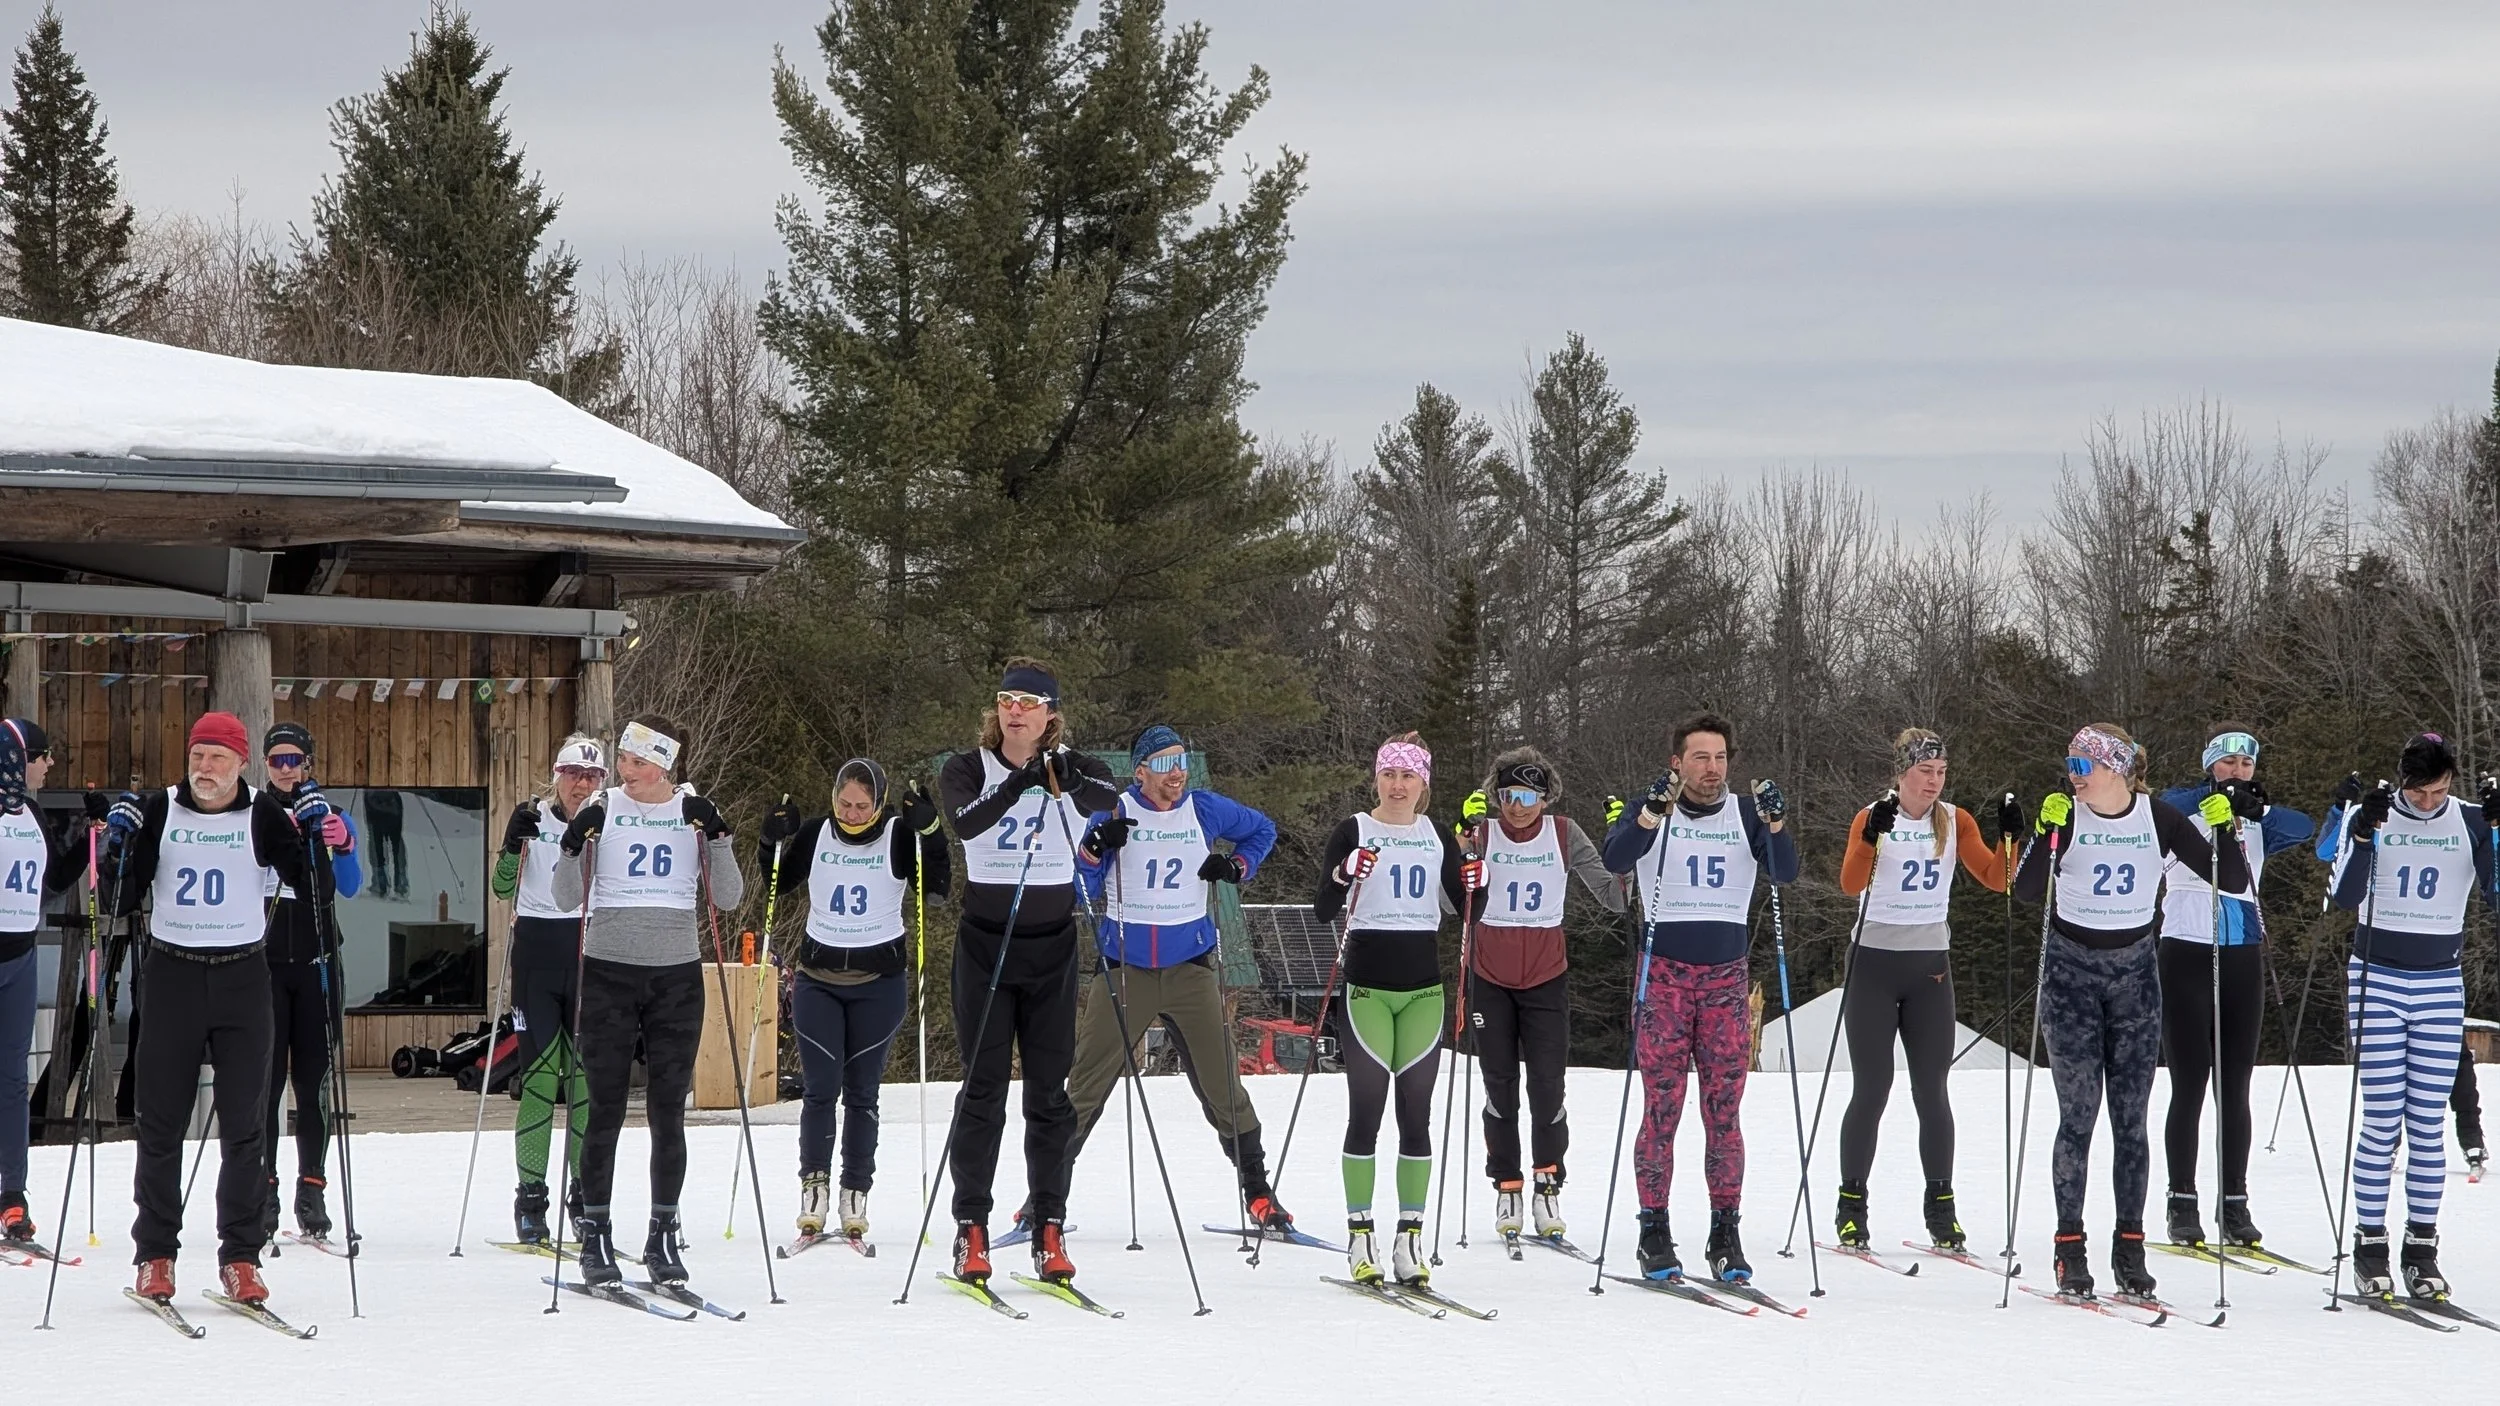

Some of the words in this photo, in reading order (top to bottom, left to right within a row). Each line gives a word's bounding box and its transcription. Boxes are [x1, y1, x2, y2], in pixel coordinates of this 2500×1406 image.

[579, 745, 599, 763] W
[196, 832, 235, 844] Concept
[237, 831, 245, 842] II
[997, 816, 1045, 851] 22
[1157, 831, 1189, 841] Concept
[1190, 829, 1197, 839] II
[1695, 830, 1730, 841] Concept
[1732, 830, 1740, 840] II
[2105, 834, 2140, 845] Concept
[2143, 833, 2151, 843] II
[1391, 837, 1426, 848] Concept
[2411, 835, 2448, 847] Concept
[2451, 836, 2459, 846] II
[628, 843, 673, 877] 26
[842, 855, 874, 866] Concept
[876, 855, 884, 864] II
[983, 860, 1016, 869] Craftsbury
[1515, 855, 1545, 865] Concept
[1547, 852, 1554, 862] II
[5, 860, 39, 895] 42
[1145, 857, 1184, 890] 12
[1686, 855, 1726, 889] 15
[1901, 859, 1941, 892] 25
[1389, 864, 1427, 899] 10
[2093, 863, 2136, 896] 23
[2397, 866, 2440, 900] 18
[176, 867, 226, 908] 20
[829, 884, 869, 916] 43
[1506, 881, 1543, 912] 13
[1123, 902, 1154, 911] Craftsbury
[1155, 903, 1180, 911] Outdoor
[1666, 901, 1697, 909] Craftsbury
[1699, 901, 1724, 909] Outdoor
[2078, 906, 2107, 916] Craftsbury
[2108, 907, 2133, 916] Outdoor
[1771, 884, 1786, 957] RUNDLE
[2409, 911, 2435, 920] Outdoor
[165, 920, 194, 931] Craftsbury
[195, 922, 225, 931] Outdoor
[226, 922, 245, 930] Center
[839, 926, 863, 934] Outdoor
[864, 923, 882, 933] Center
